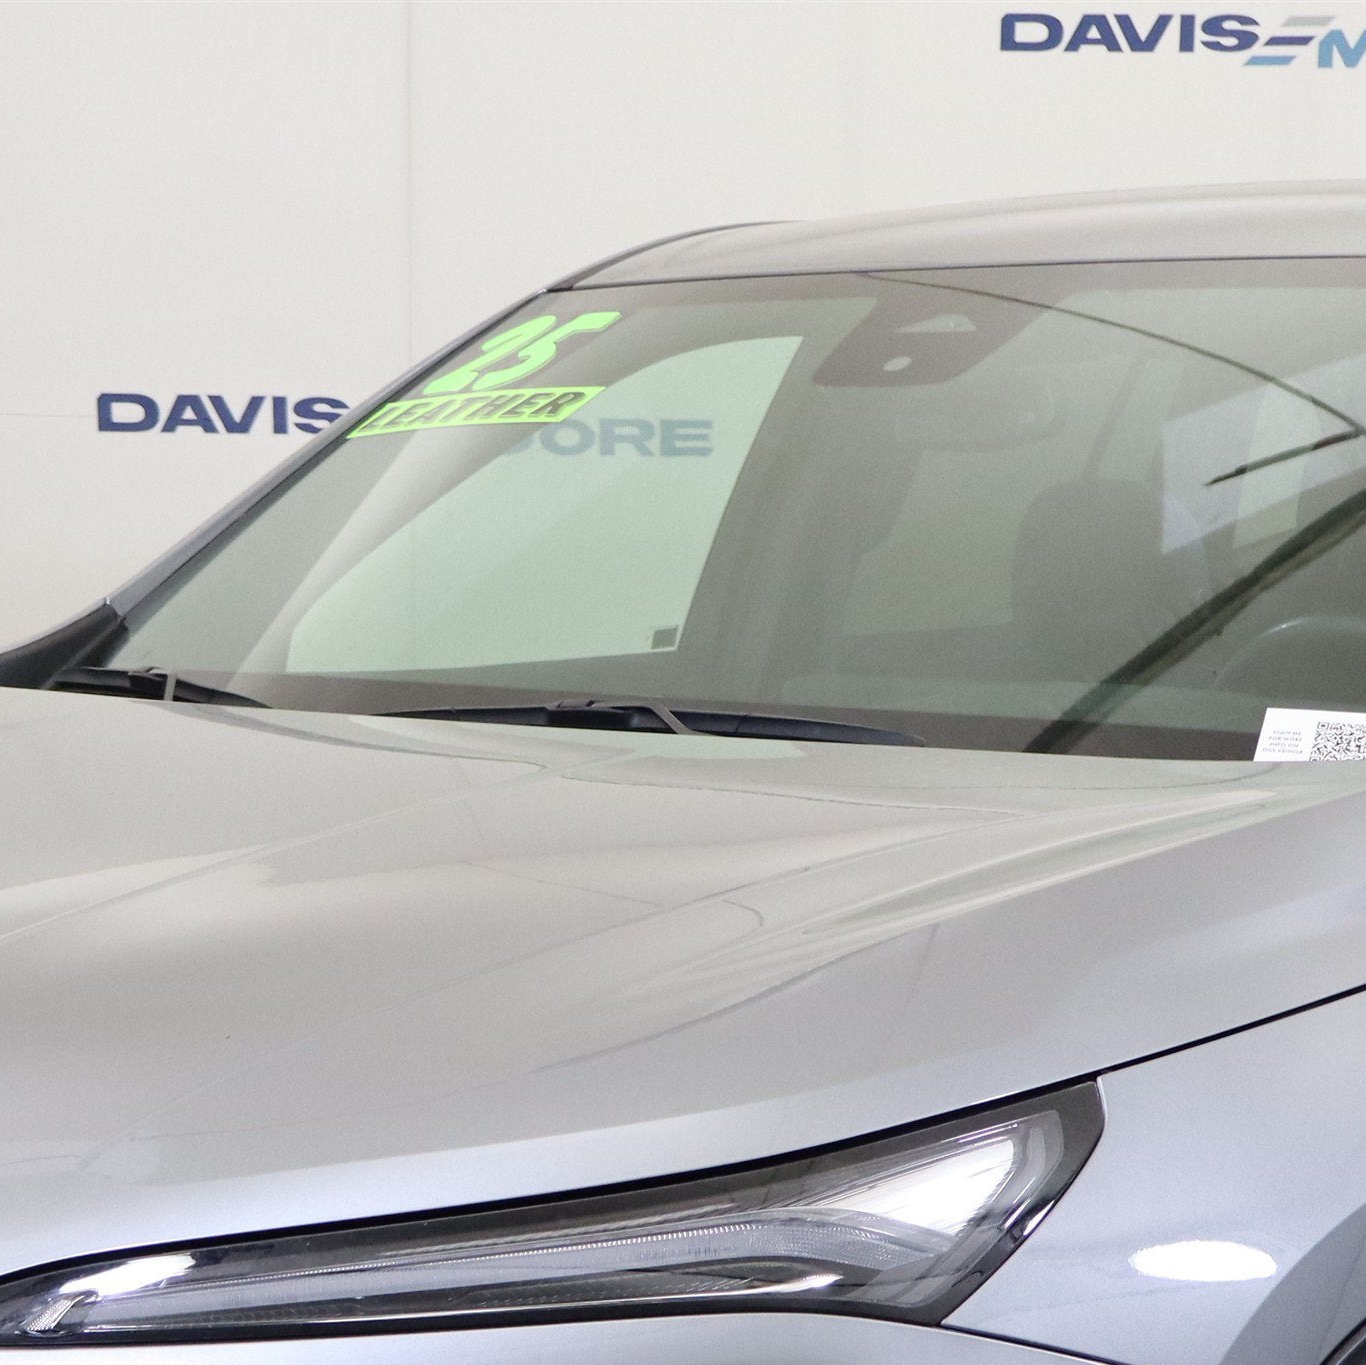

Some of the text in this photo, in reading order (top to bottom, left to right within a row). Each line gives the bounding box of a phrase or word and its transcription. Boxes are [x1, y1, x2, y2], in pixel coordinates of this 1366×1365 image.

[999, 12, 1263, 54] DAVIS
[422, 311, 623, 396] 25
[96, 393, 714, 457] DAVIS ORE
[358, 390, 587, 433] LEATHER
